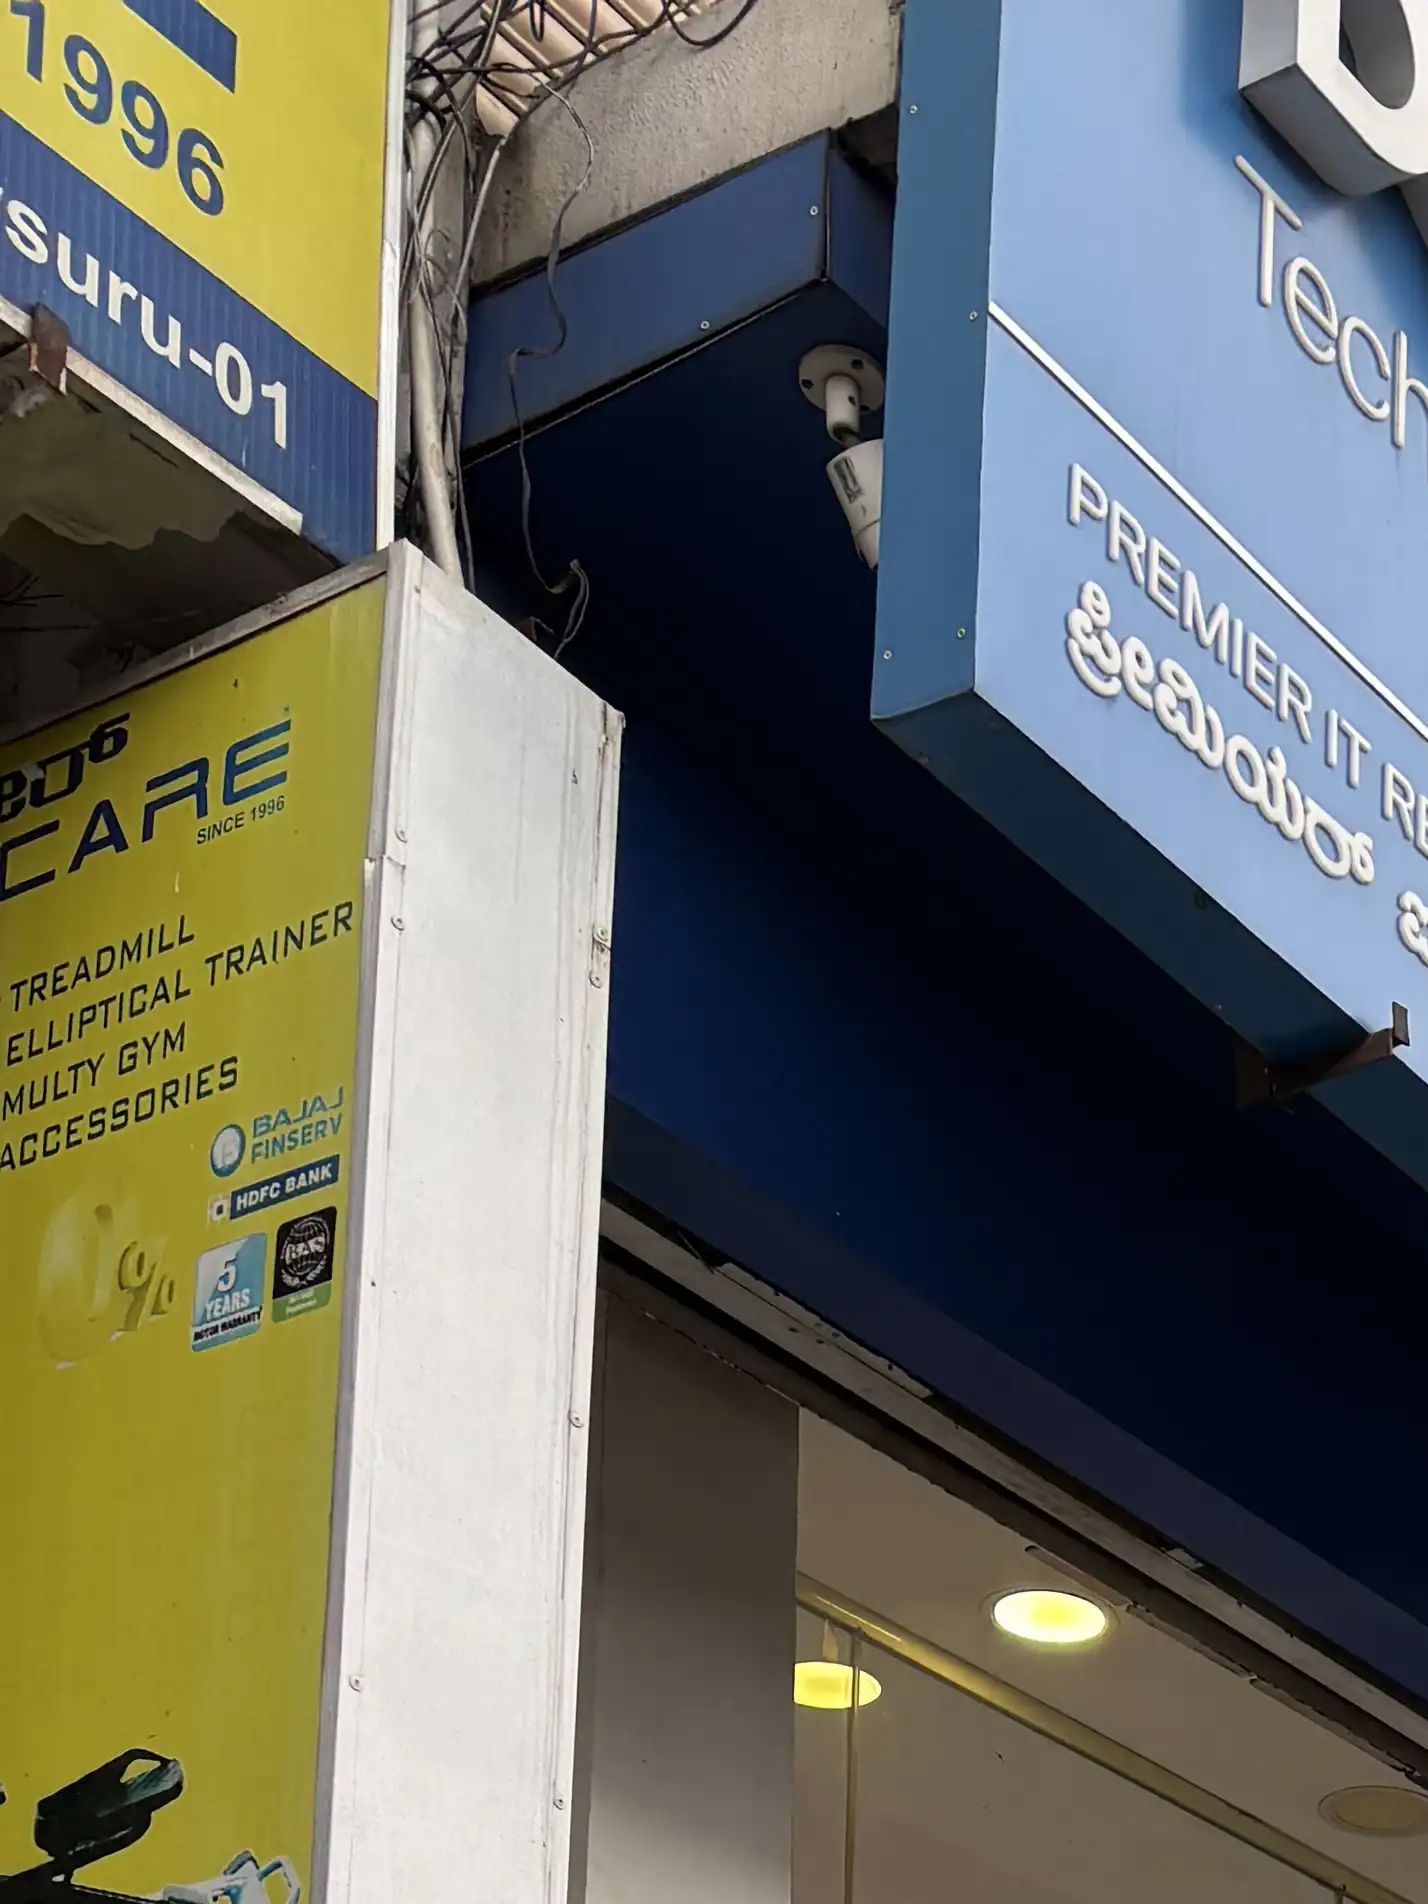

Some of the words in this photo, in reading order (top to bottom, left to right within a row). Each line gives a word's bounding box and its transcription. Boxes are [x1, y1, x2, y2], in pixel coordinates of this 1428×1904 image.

[8, 0, 225, 217] 1996
[0, 183, 289, 449] suru-01
[1068, 463, 1313, 744] PREMIER
[1328, 710, 1371, 788] IT
[0, 719, 292, 901] CARE
[195, 811, 245, 846] SINCE
[249, 795, 286, 832] 1996
[6, 968, 191, 1067] ELLIPTICAL
[205, 900, 354, 987] TRAINER
[8, 914, 196, 1013] TREADMILL
[0, 1051, 105, 1122] MULTY
[118, 1021, 187, 1076] GYM
[0, 1054, 240, 1171] ACCESSORIES
[252, 1086, 344, 1138] BAJAJ
[236, 1183, 280, 1211] HDFC
[285, 1163, 332, 1195] BANK
[251, 1113, 342, 1164] FINSERV
[203, 1288, 251, 1320] YEARS
[217, 1252, 237, 1292] 5
